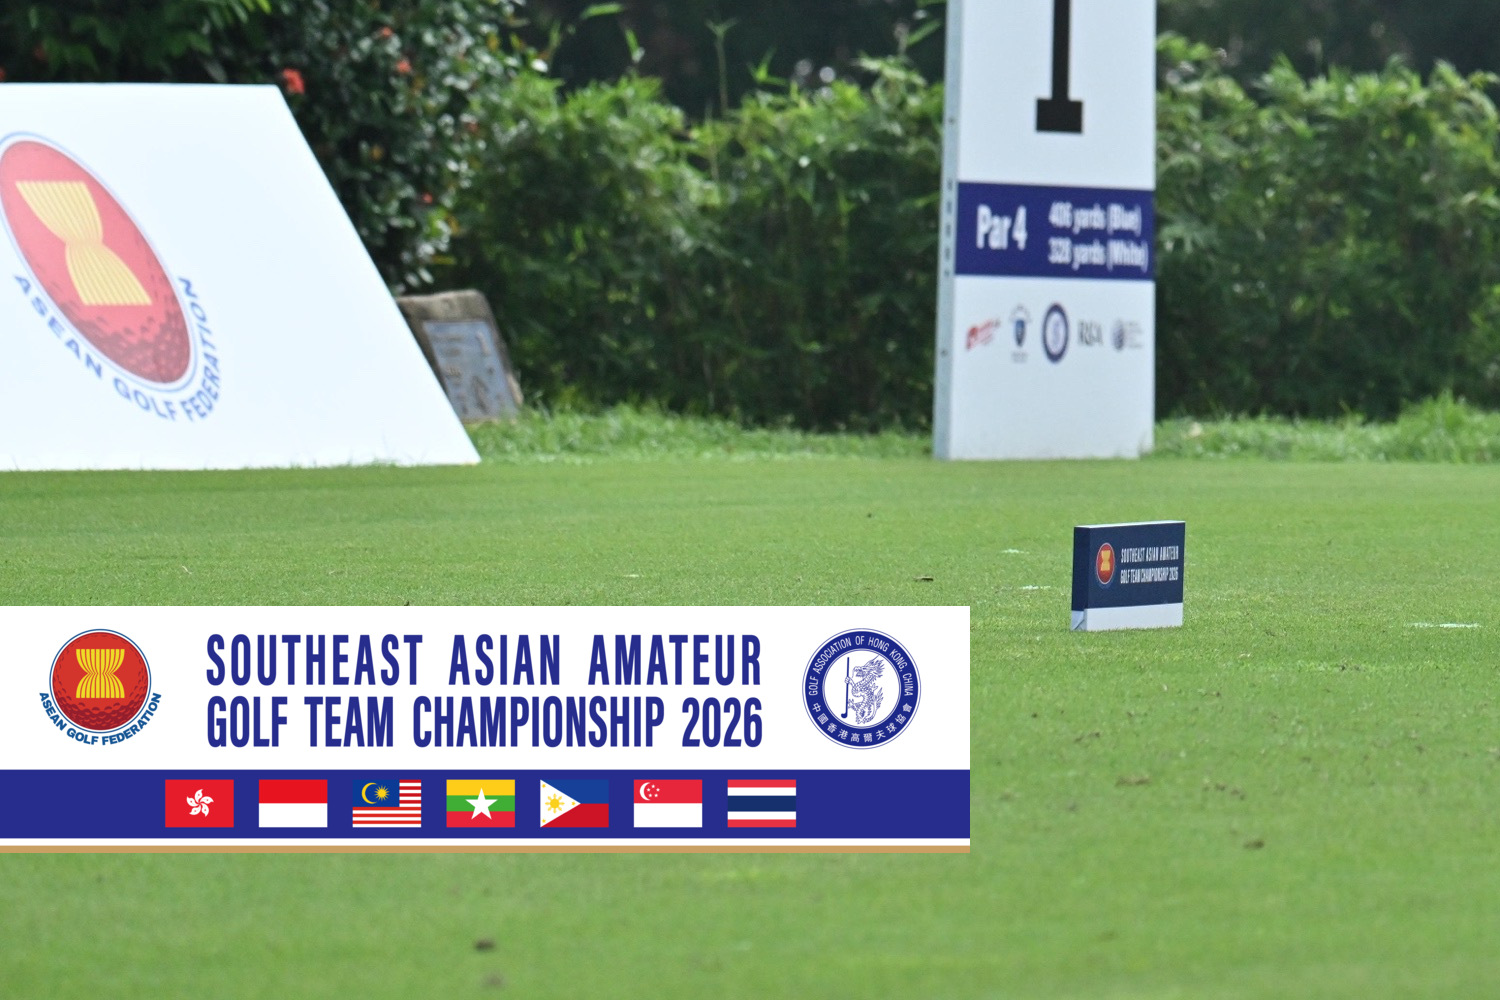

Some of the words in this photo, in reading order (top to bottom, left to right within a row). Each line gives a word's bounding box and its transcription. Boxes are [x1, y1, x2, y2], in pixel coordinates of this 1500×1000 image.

[976, 203, 1012, 250] Par
[1012, 204, 1028, 250] 4
[1072, 203, 1106, 235] yards
[1106, 203, 1142, 237] (Blue)
[1071, 239, 1106, 271] yards
[1106, 239, 1149, 273] (White)
[14, 275, 102, 379] ASEAN
[113, 377, 176, 421] GOLF
[177, 276, 220, 422] FEDERATION
[1120, 547, 1145, 563] SOUTHEAST
[1146, 546, 1159, 562] ASIAN
[1160, 545, 1179, 561] AMATEUR
[1120, 569, 1130, 584] GOLF
[1130, 568, 1140, 583] TEAM
[1140, 567, 1168, 582] CHAMPIONSHIP
